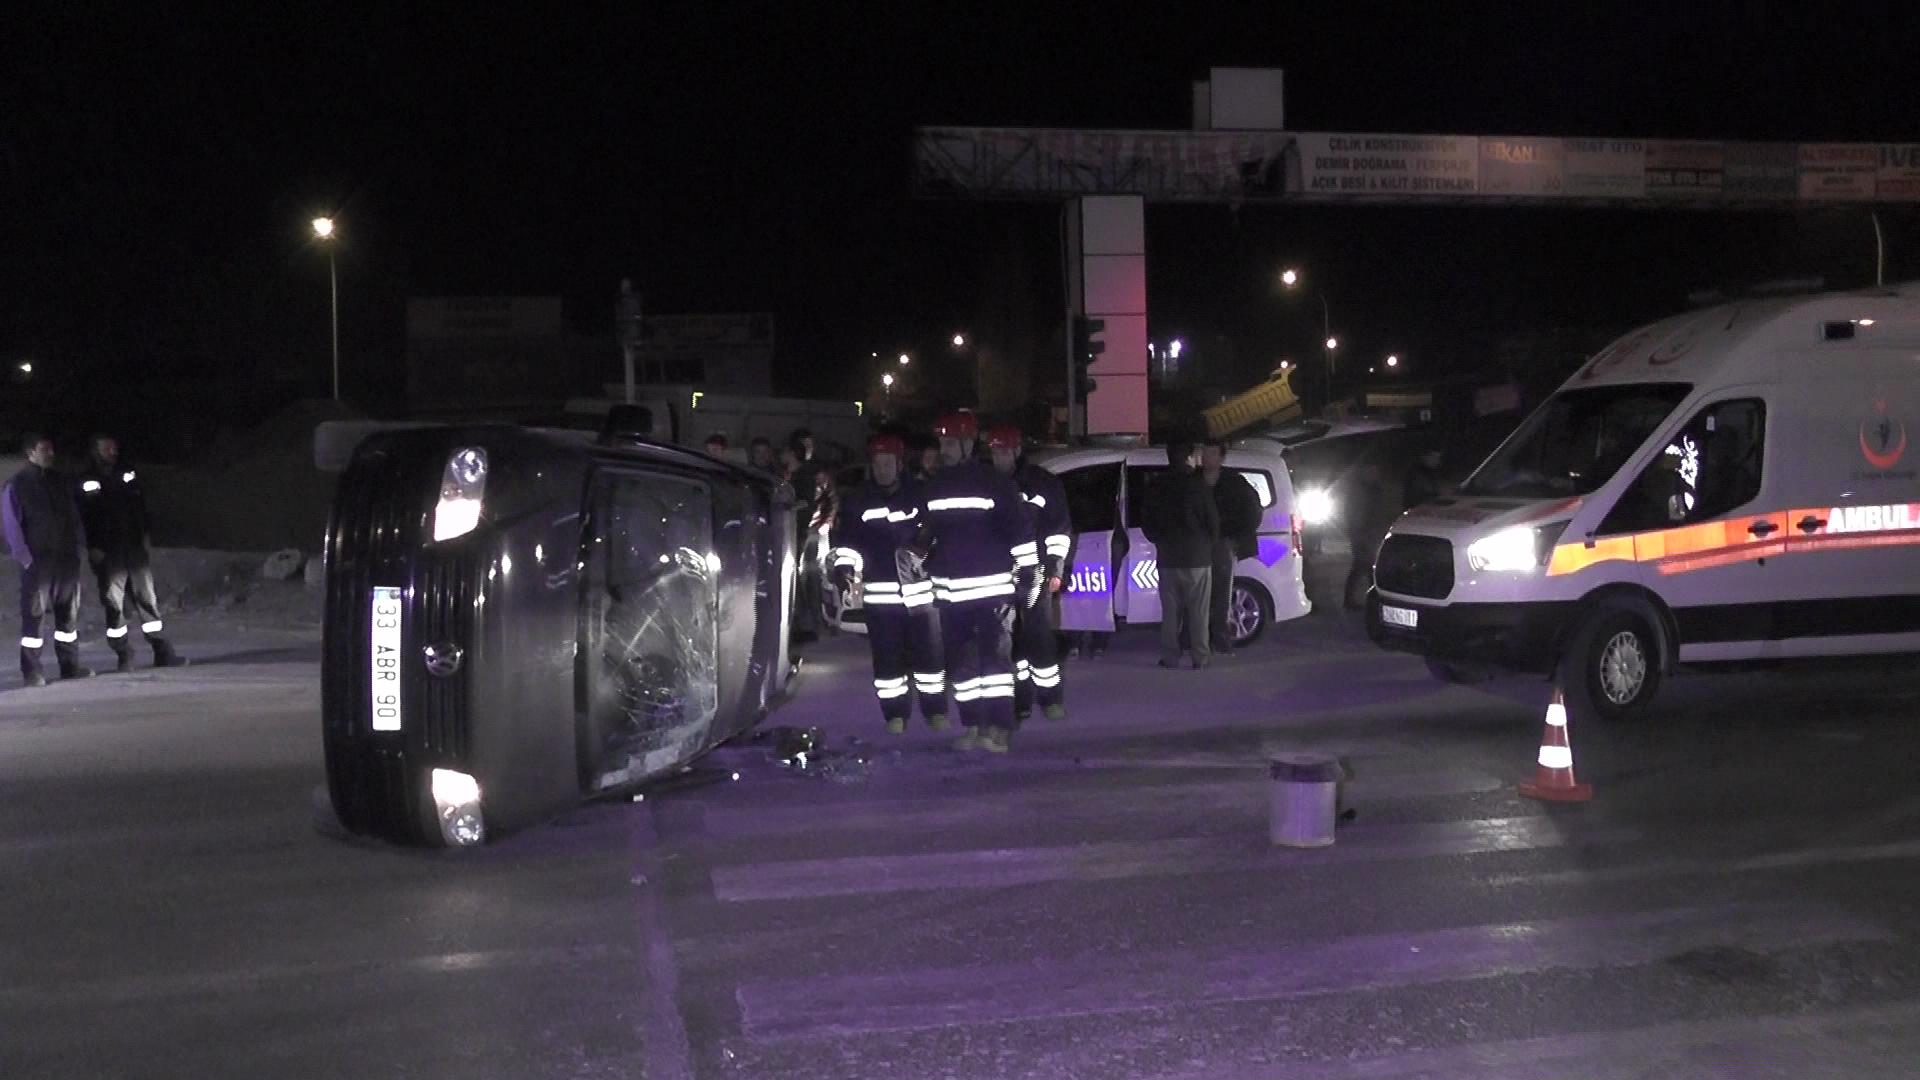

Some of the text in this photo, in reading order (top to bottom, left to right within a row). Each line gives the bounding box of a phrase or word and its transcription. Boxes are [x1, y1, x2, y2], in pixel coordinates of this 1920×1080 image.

[1826, 503, 1920, 533] AMBUL
[377, 605, 396, 718] 33 ABR 90
